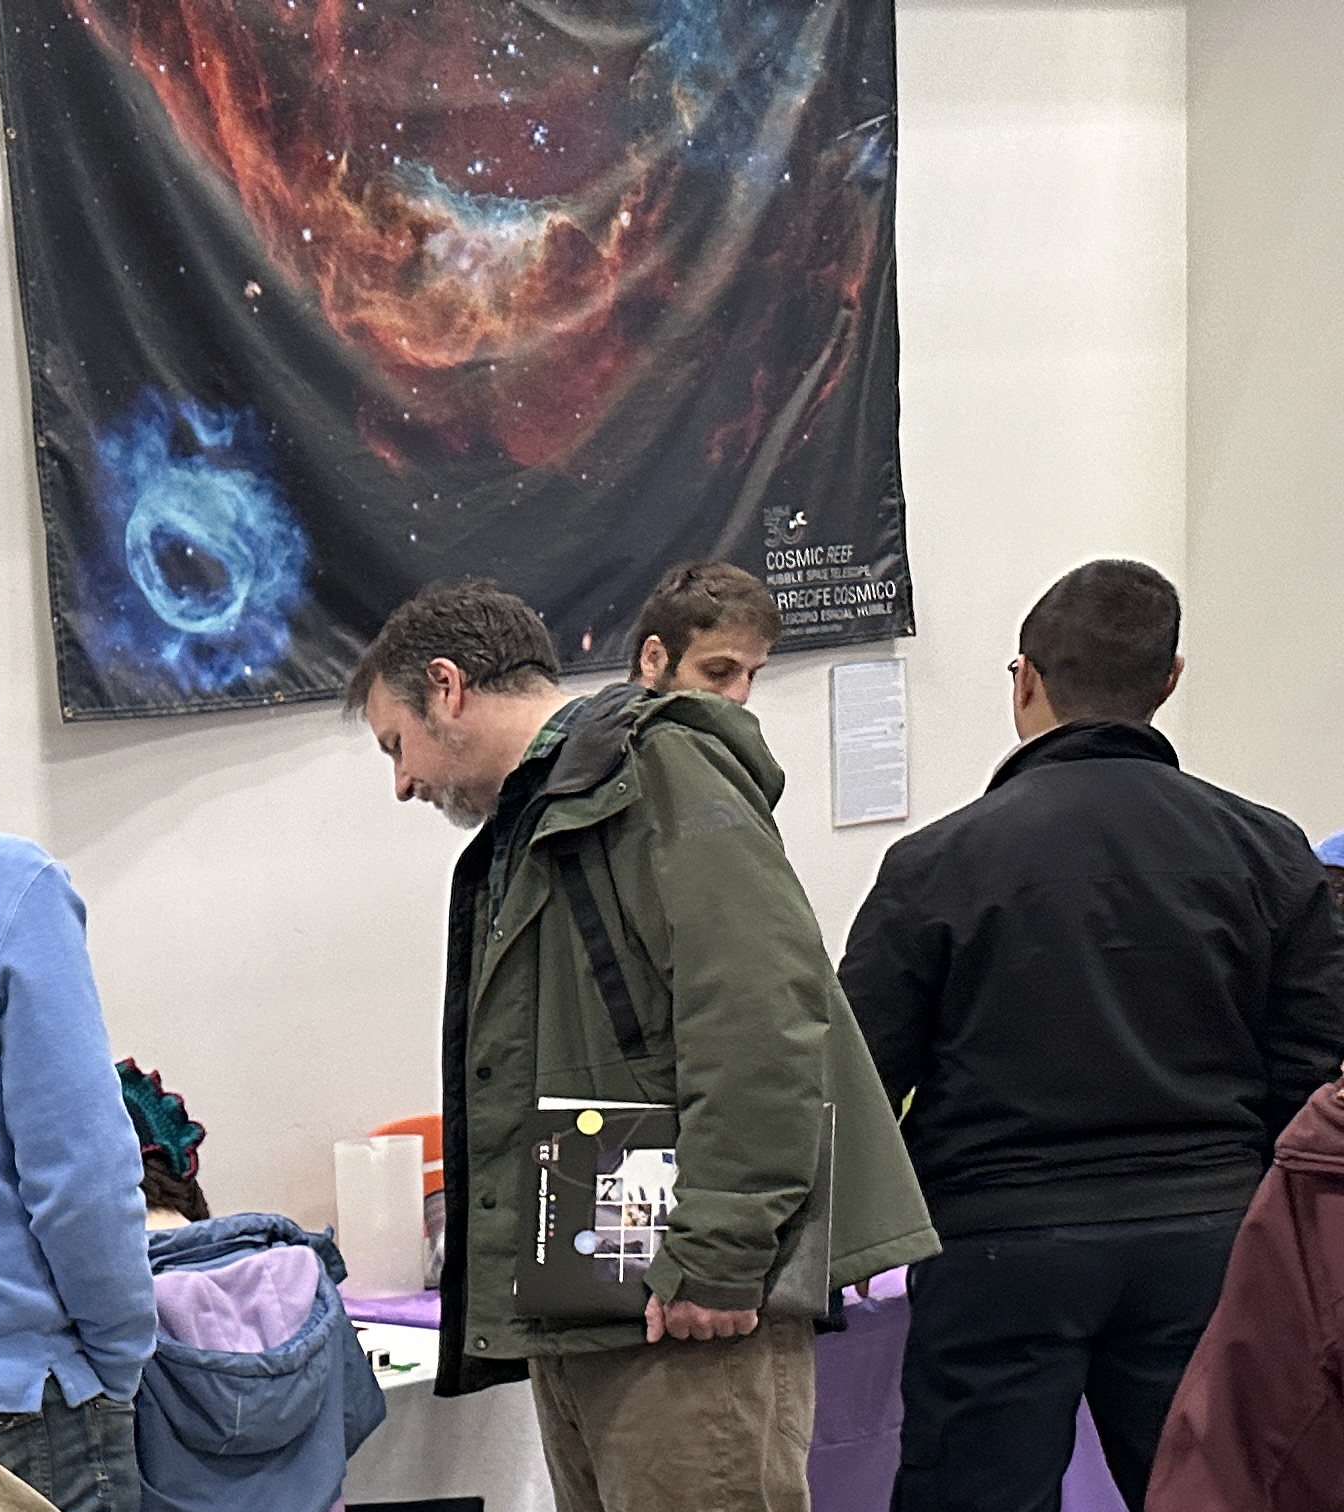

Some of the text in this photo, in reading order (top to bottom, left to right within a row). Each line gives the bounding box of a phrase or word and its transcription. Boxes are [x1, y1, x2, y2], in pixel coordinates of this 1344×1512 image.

[766, 544, 854, 571] COSMIC REEF
[769, 587, 831, 611] RRECIFE
